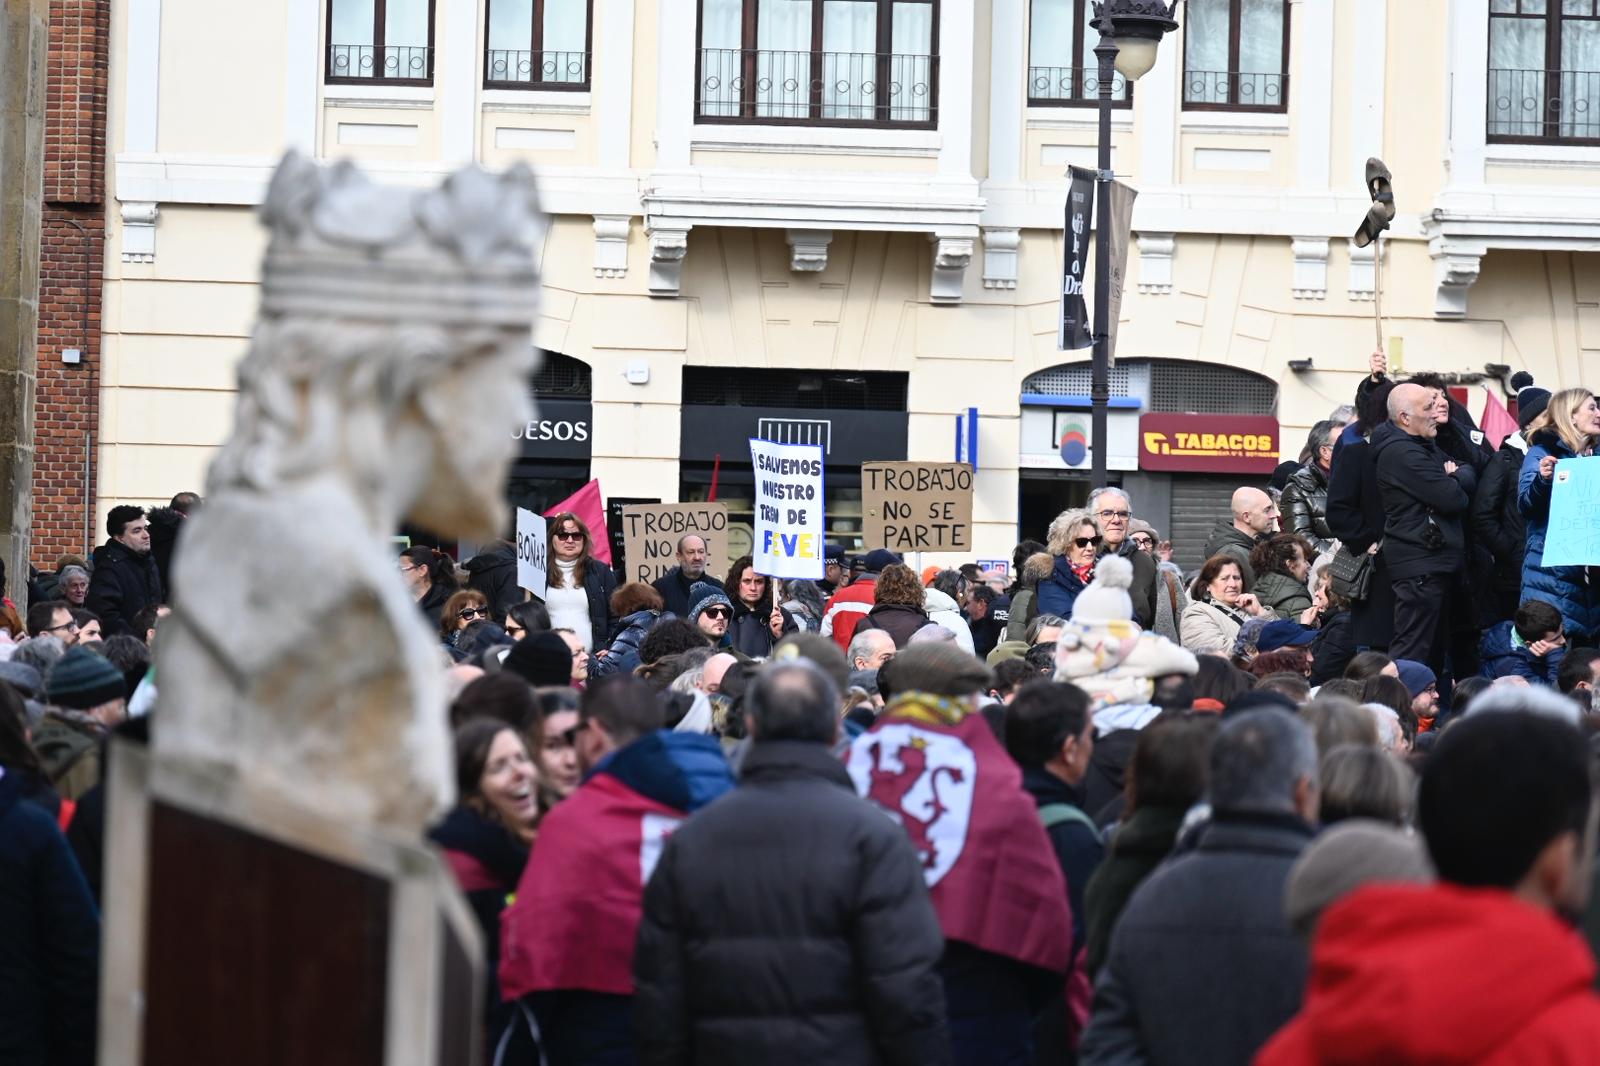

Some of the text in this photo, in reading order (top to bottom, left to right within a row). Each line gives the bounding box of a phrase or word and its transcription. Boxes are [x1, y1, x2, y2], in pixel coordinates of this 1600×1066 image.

[1174, 432, 1272, 451] TABACOS
[762, 479, 815, 501] NUESTRO
[863, 467, 971, 491] TROBAJO
[760, 503, 807, 526] TREN DE
[883, 500, 956, 521] NO SE
[624, 511, 726, 537] TROBAJO
[763, 530, 821, 560] FEVE!
[884, 523, 966, 549] PARTE
[517, 531, 546, 573] BOÑAR
[644, 539, 672, 559] NO
